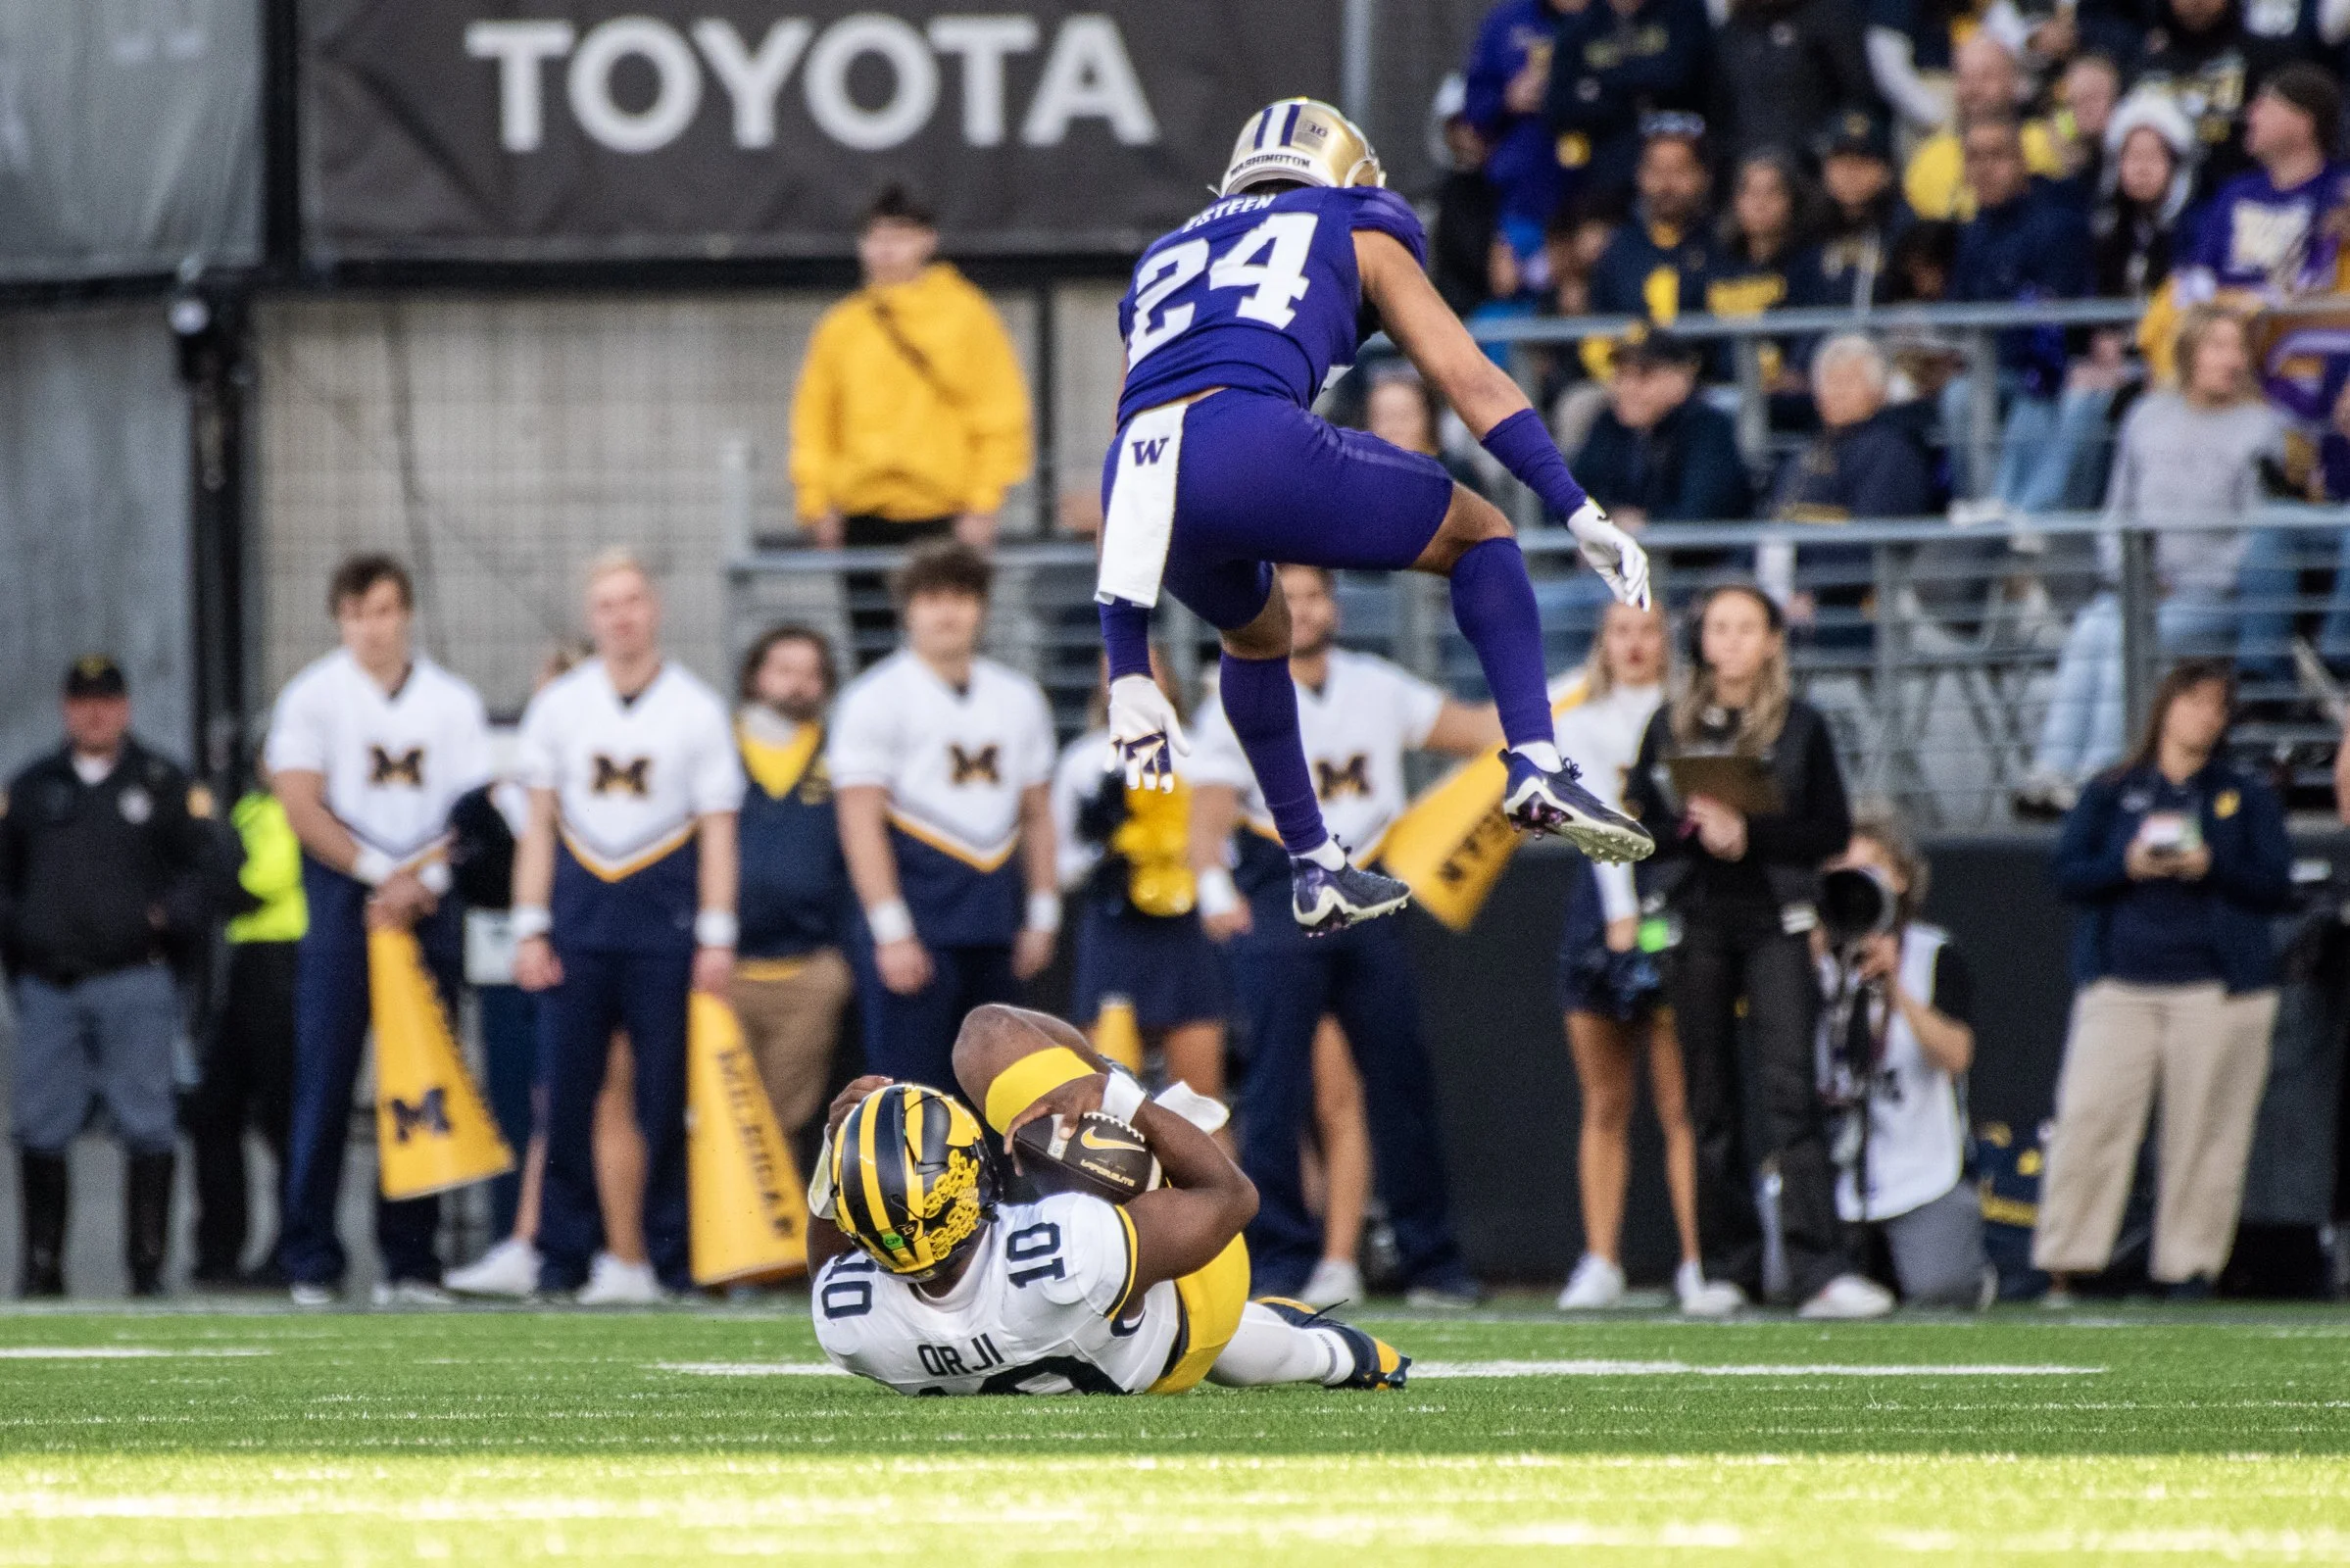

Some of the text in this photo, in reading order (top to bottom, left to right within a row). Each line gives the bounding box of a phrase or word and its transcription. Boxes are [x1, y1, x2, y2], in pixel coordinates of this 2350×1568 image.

[465, 12, 1159, 154] TOYOTA
[1127, 211, 1319, 370] 24
[1131, 436, 1170, 467] W
[371, 745, 423, 787] M
[594, 755, 649, 796] M
[950, 743, 1001, 786] M
[1315, 754, 1371, 801] M
[392, 1087, 451, 1144] M
[1005, 1221, 1066, 1289] 10
[916, 1333, 1005, 1377] ORJI
